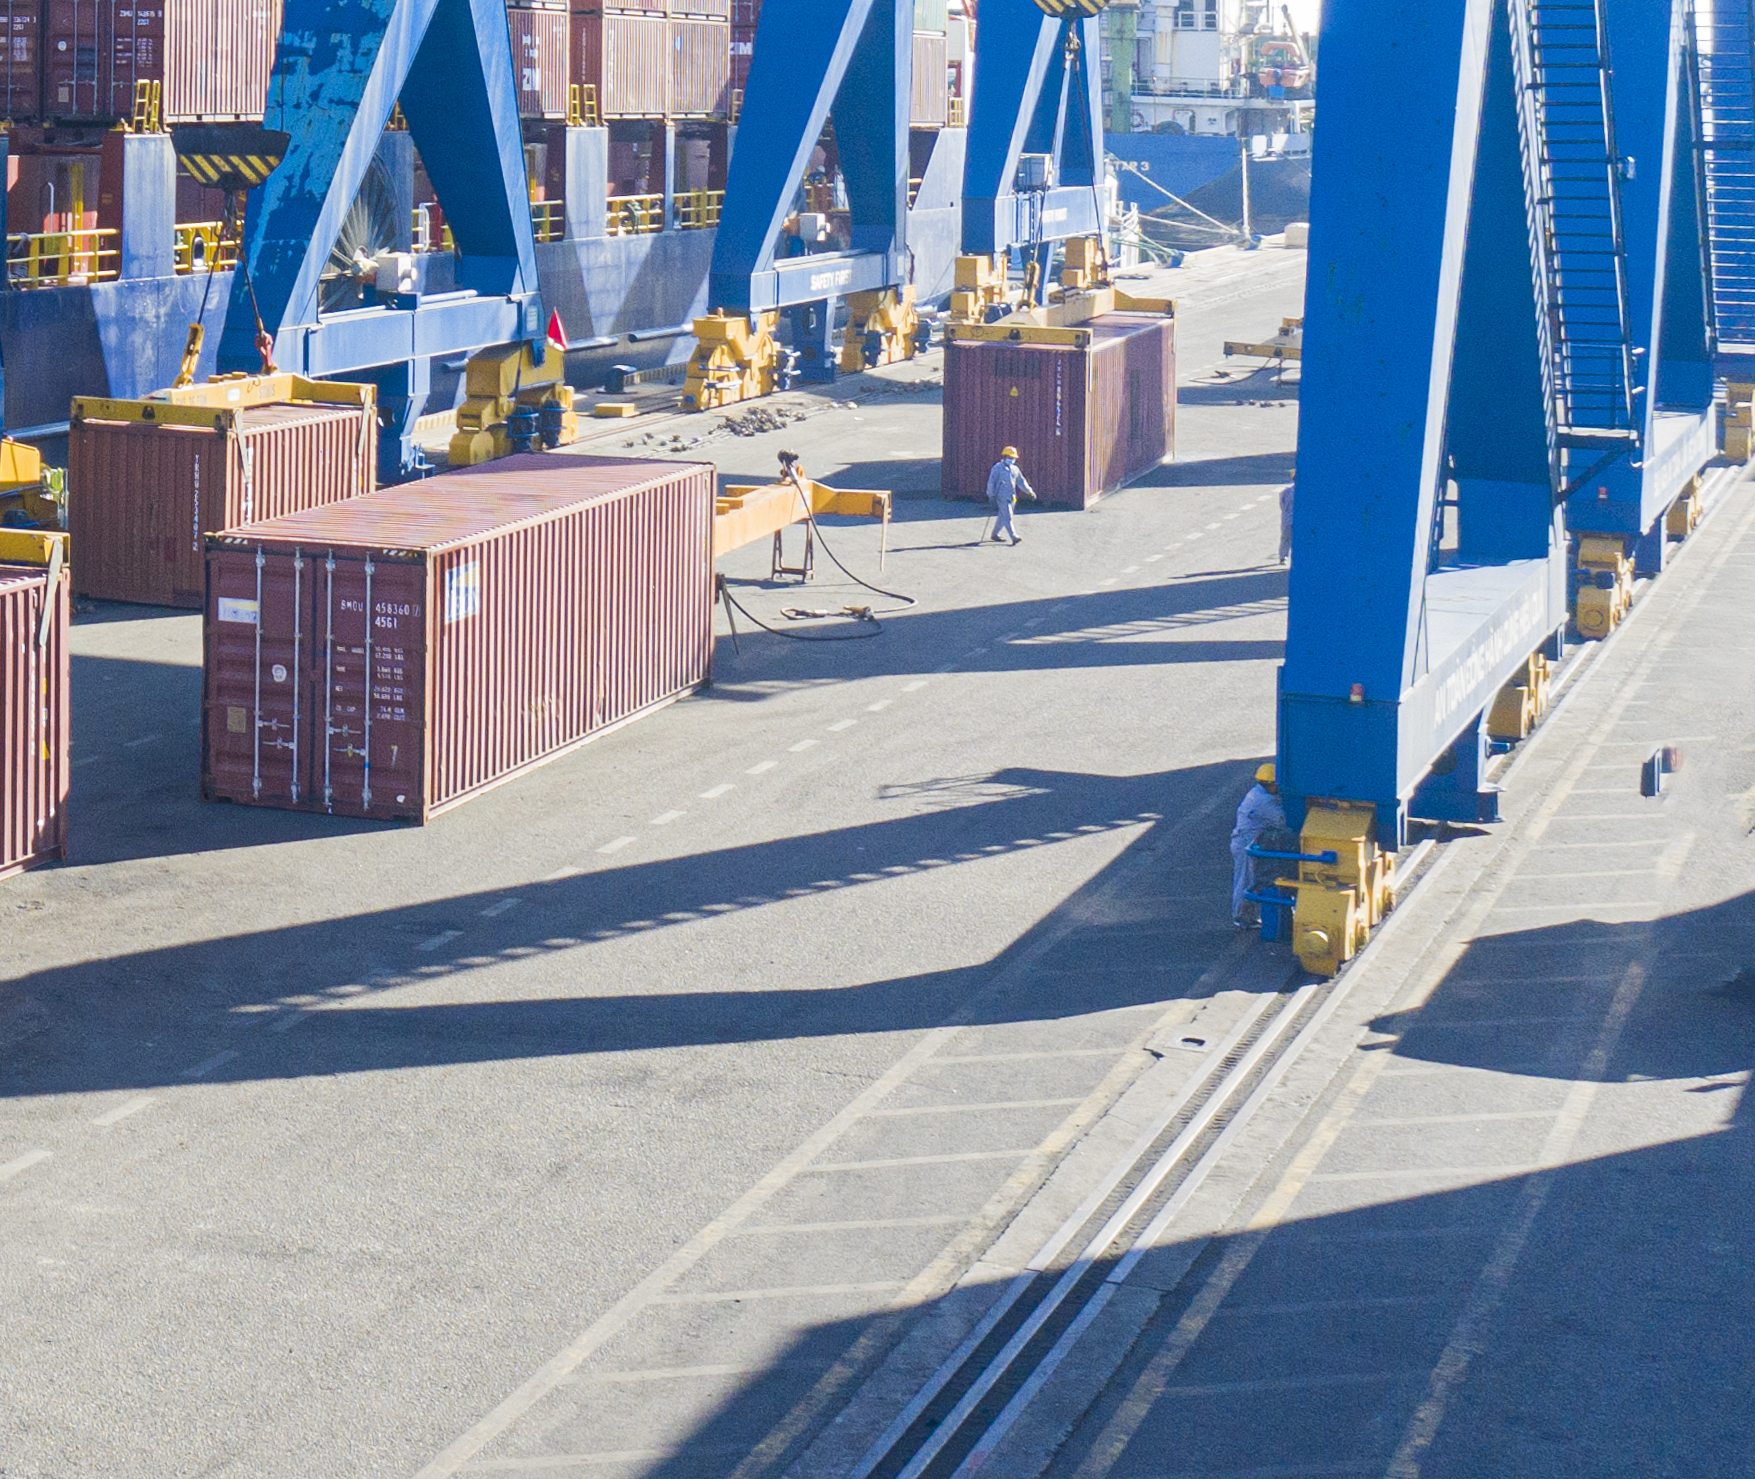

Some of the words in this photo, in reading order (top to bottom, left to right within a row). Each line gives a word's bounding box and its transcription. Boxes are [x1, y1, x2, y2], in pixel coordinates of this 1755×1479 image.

[1114, 161, 1139, 171] TAR
[1141, 161, 1150, 171] 3
[811, 272, 835, 291] SAFETY
[341, 600, 364, 612] BMOU
[375, 602, 410, 615] 458360
[375, 616, 398, 629] 45G1
